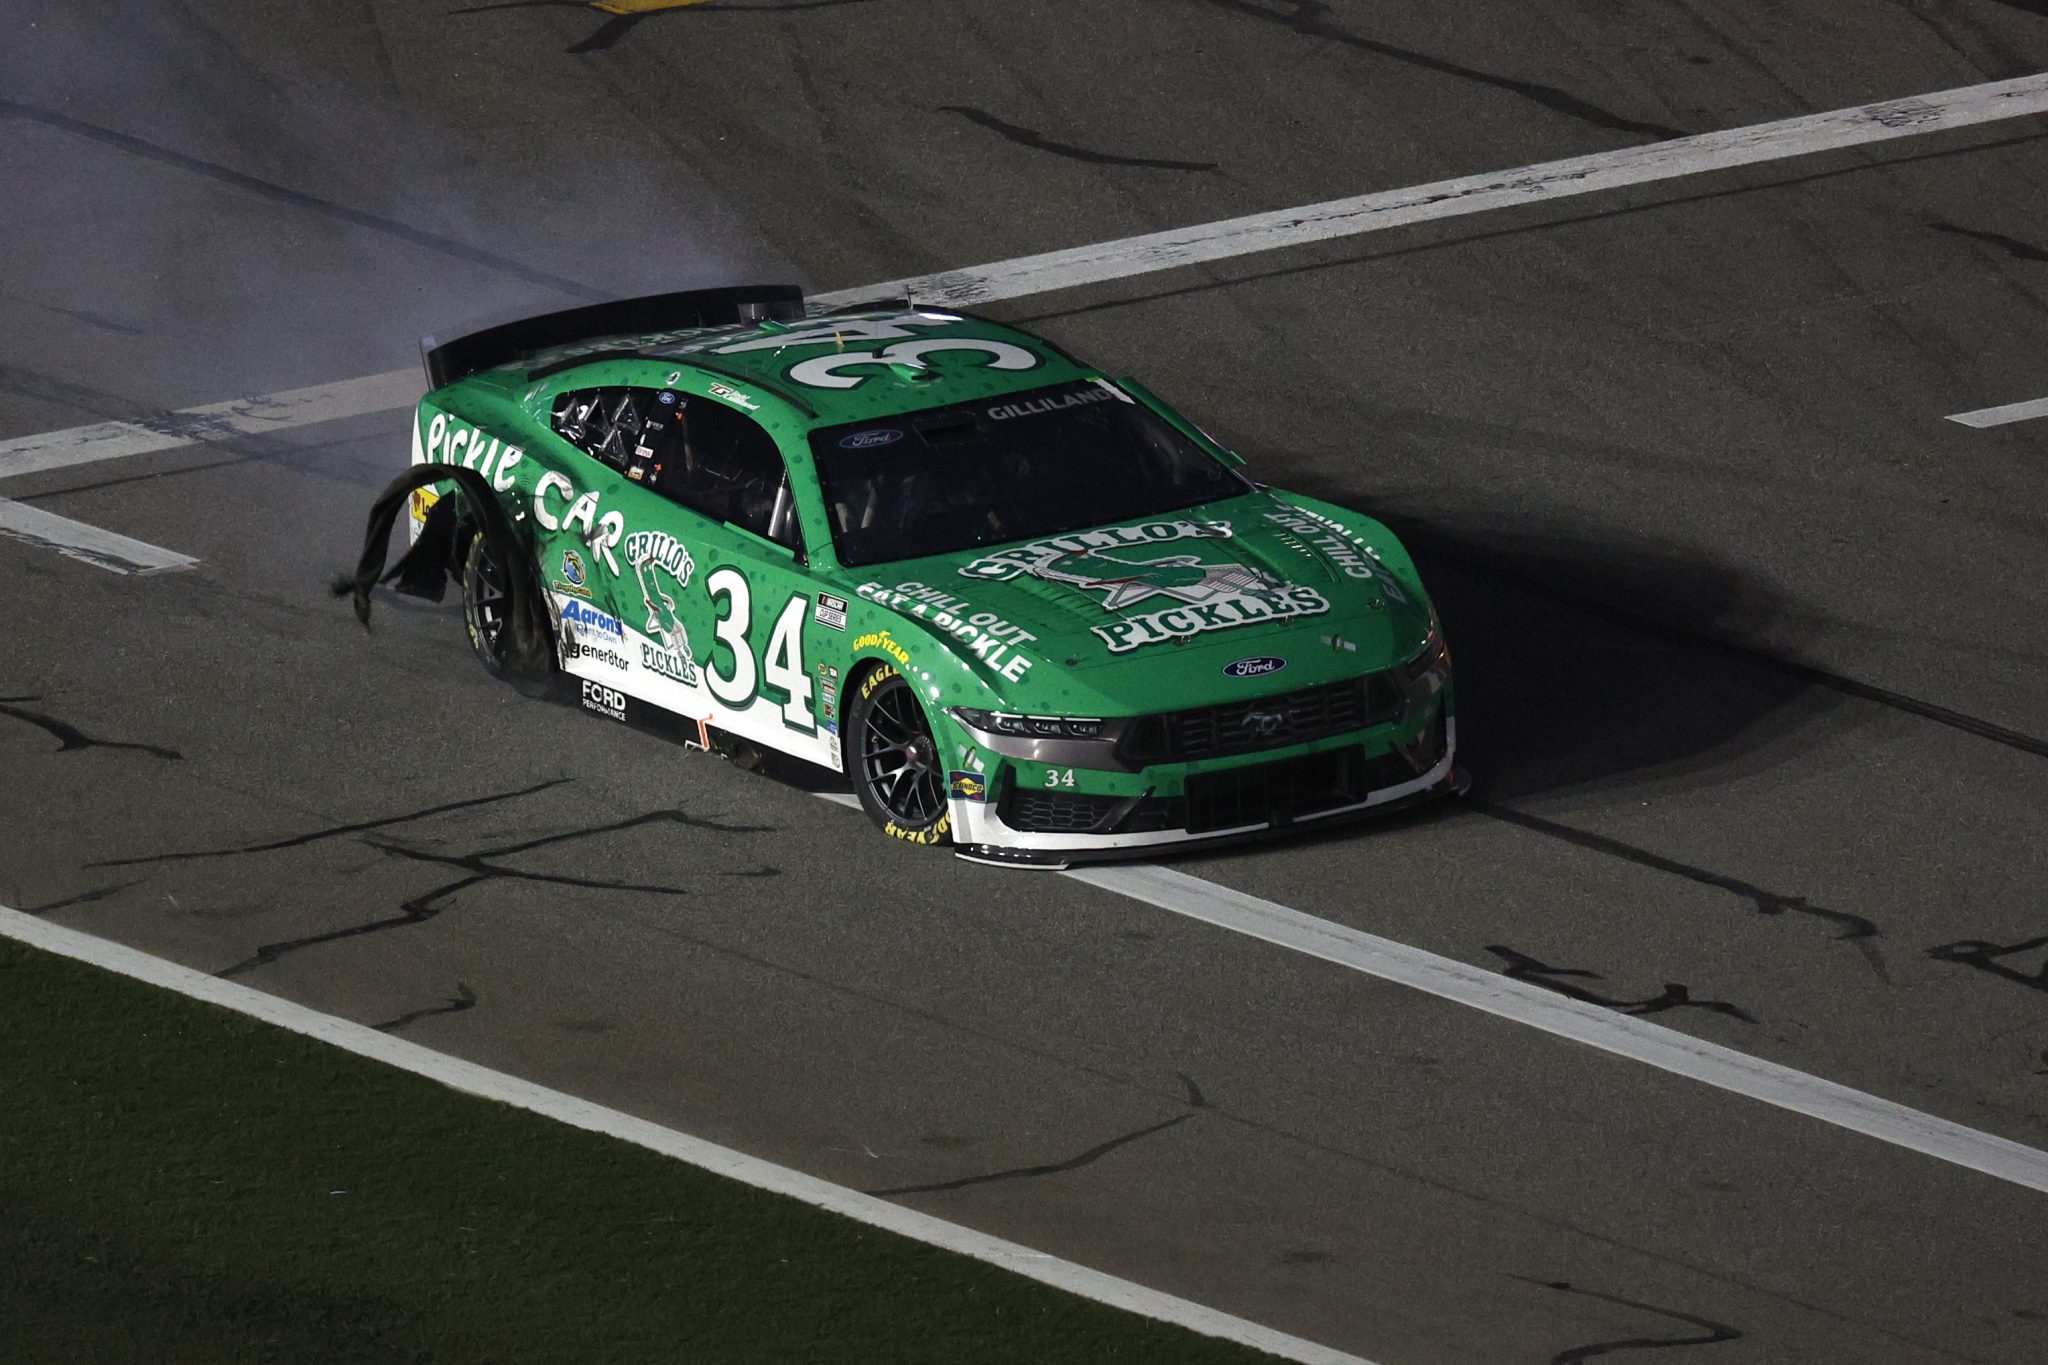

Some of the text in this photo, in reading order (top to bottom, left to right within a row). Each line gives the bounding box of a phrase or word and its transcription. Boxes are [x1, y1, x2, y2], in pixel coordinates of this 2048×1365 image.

[988, 389, 1112, 420] GILLILAND
[427, 413, 624, 577] Pickle CAR
[626, 532, 694, 586] GRILLO'S
[961, 522, 1233, 580] GRILLO'S
[855, 581, 1032, 683] EAT A PICKLE
[896, 582, 1037, 646] CHILL OUT
[1093, 588, 1328, 651] PICKLES
[641, 643, 698, 685] PICKLES
[705, 567, 816, 732] 34
[582, 680, 626, 710] FORD
[582, 698, 626, 721] PERFORMANCE
[951, 781, 985, 793] SUNOCO
[1044, 769, 1075, 787] 34
